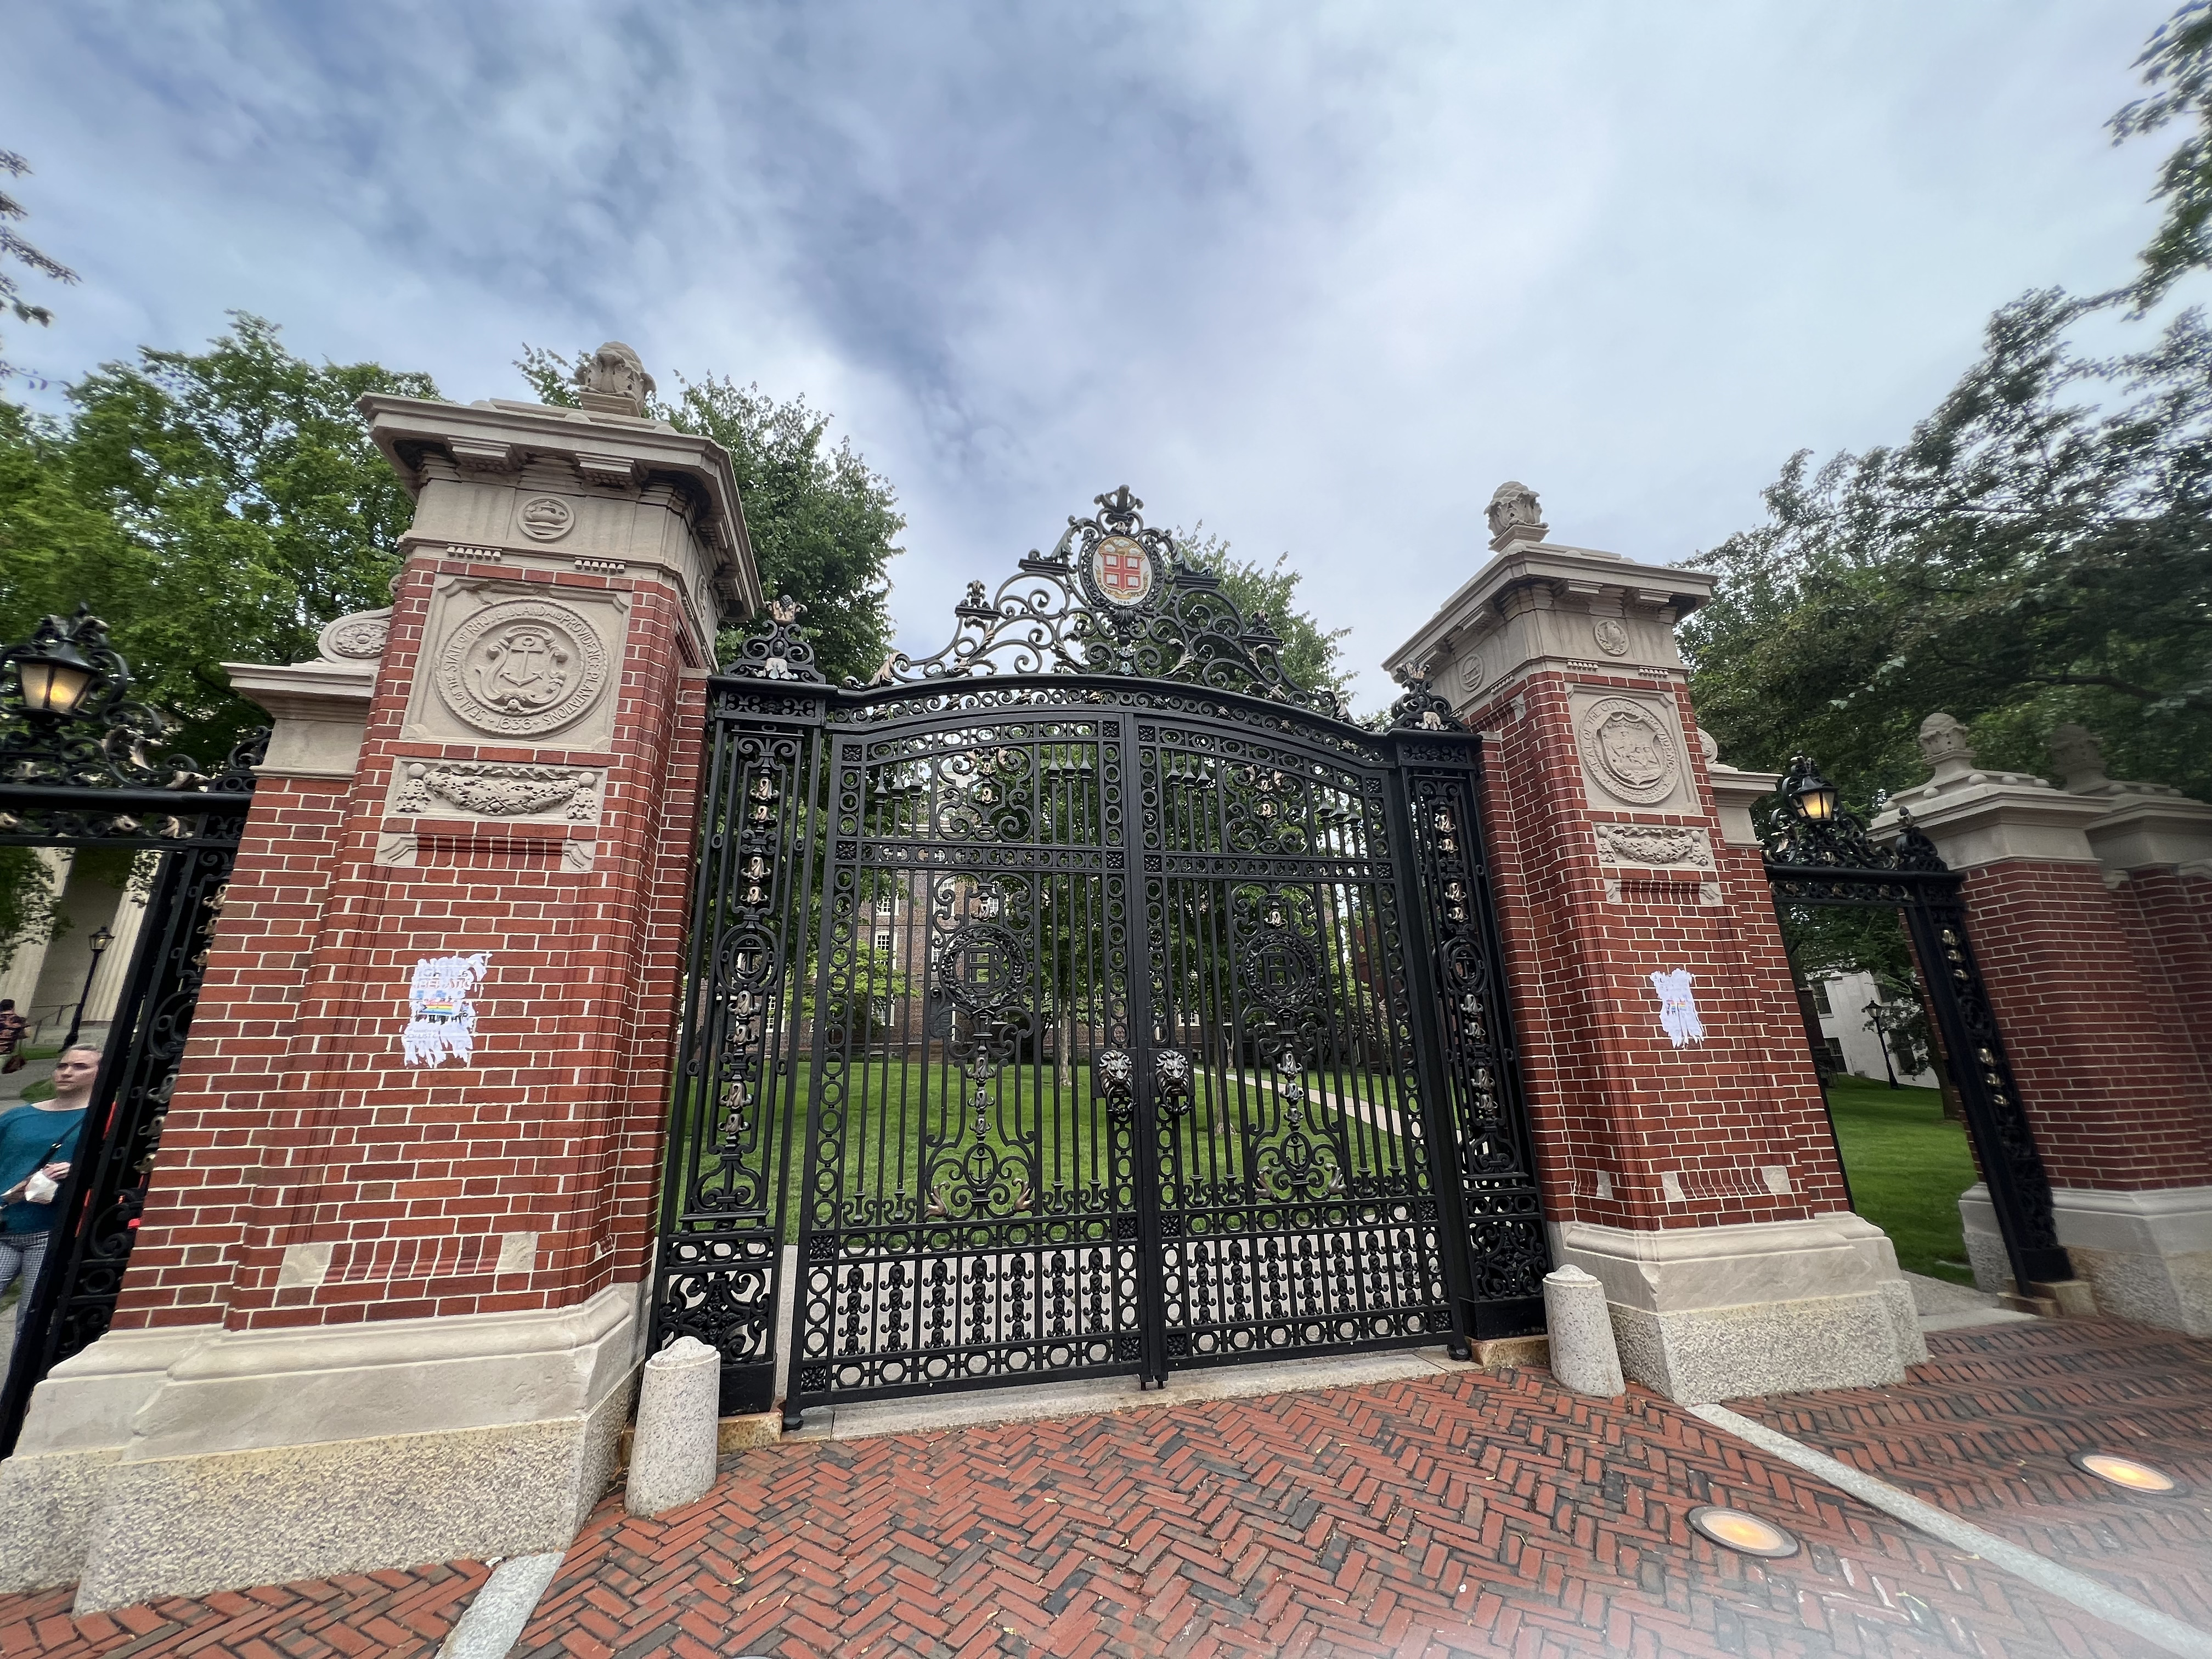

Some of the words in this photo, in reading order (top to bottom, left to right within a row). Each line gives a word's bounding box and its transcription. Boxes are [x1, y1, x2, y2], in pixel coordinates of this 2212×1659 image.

[444, 644, 466, 673] STATE
[561, 614, 601, 668] PROVIDENCE
[460, 697, 489, 721] SEAL
[541, 672, 599, 725] PLANTATIONS
[495, 718, 533, 730] 1636
[1585, 709, 1601, 725] THE
[1599, 701, 1622, 713] CITY
[1642, 710, 1675, 774] PROVIDENCE
